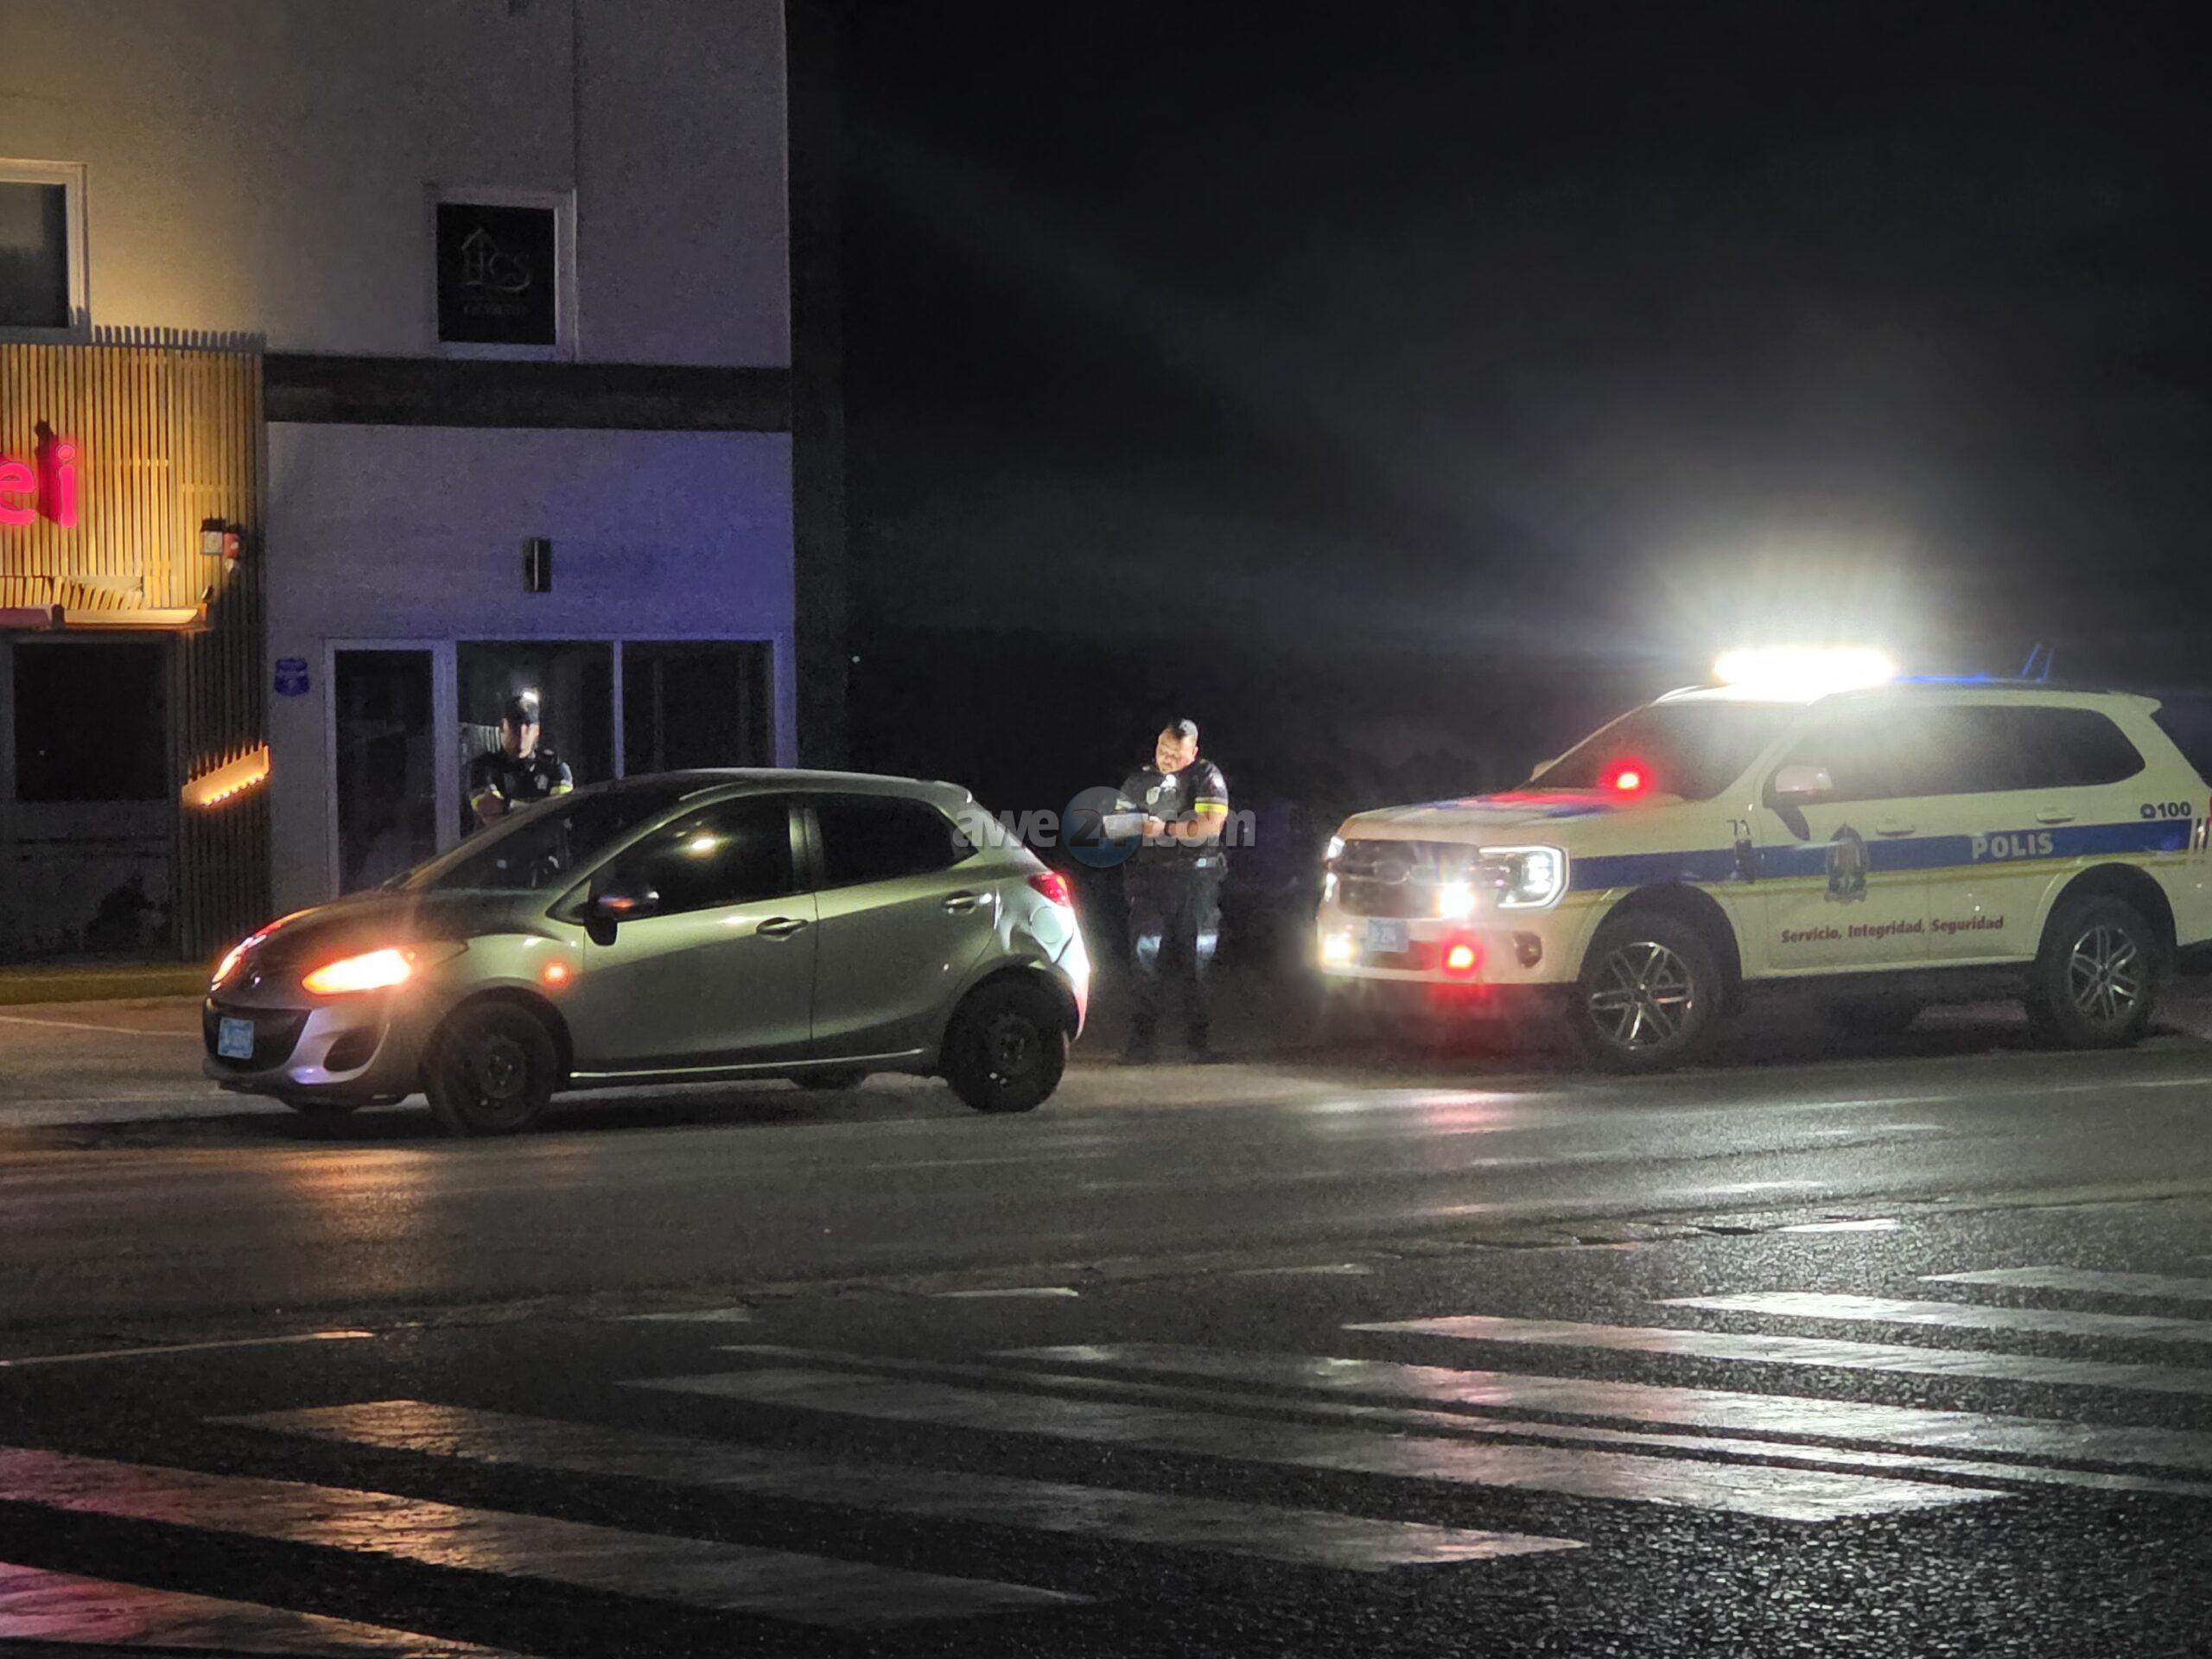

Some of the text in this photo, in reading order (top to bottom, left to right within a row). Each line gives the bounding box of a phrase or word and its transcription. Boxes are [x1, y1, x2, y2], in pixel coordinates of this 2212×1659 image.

[1971, 832, 2054, 860] POLIS
[1781, 915, 2004, 944] Servicio, Integridad, Seguridad
